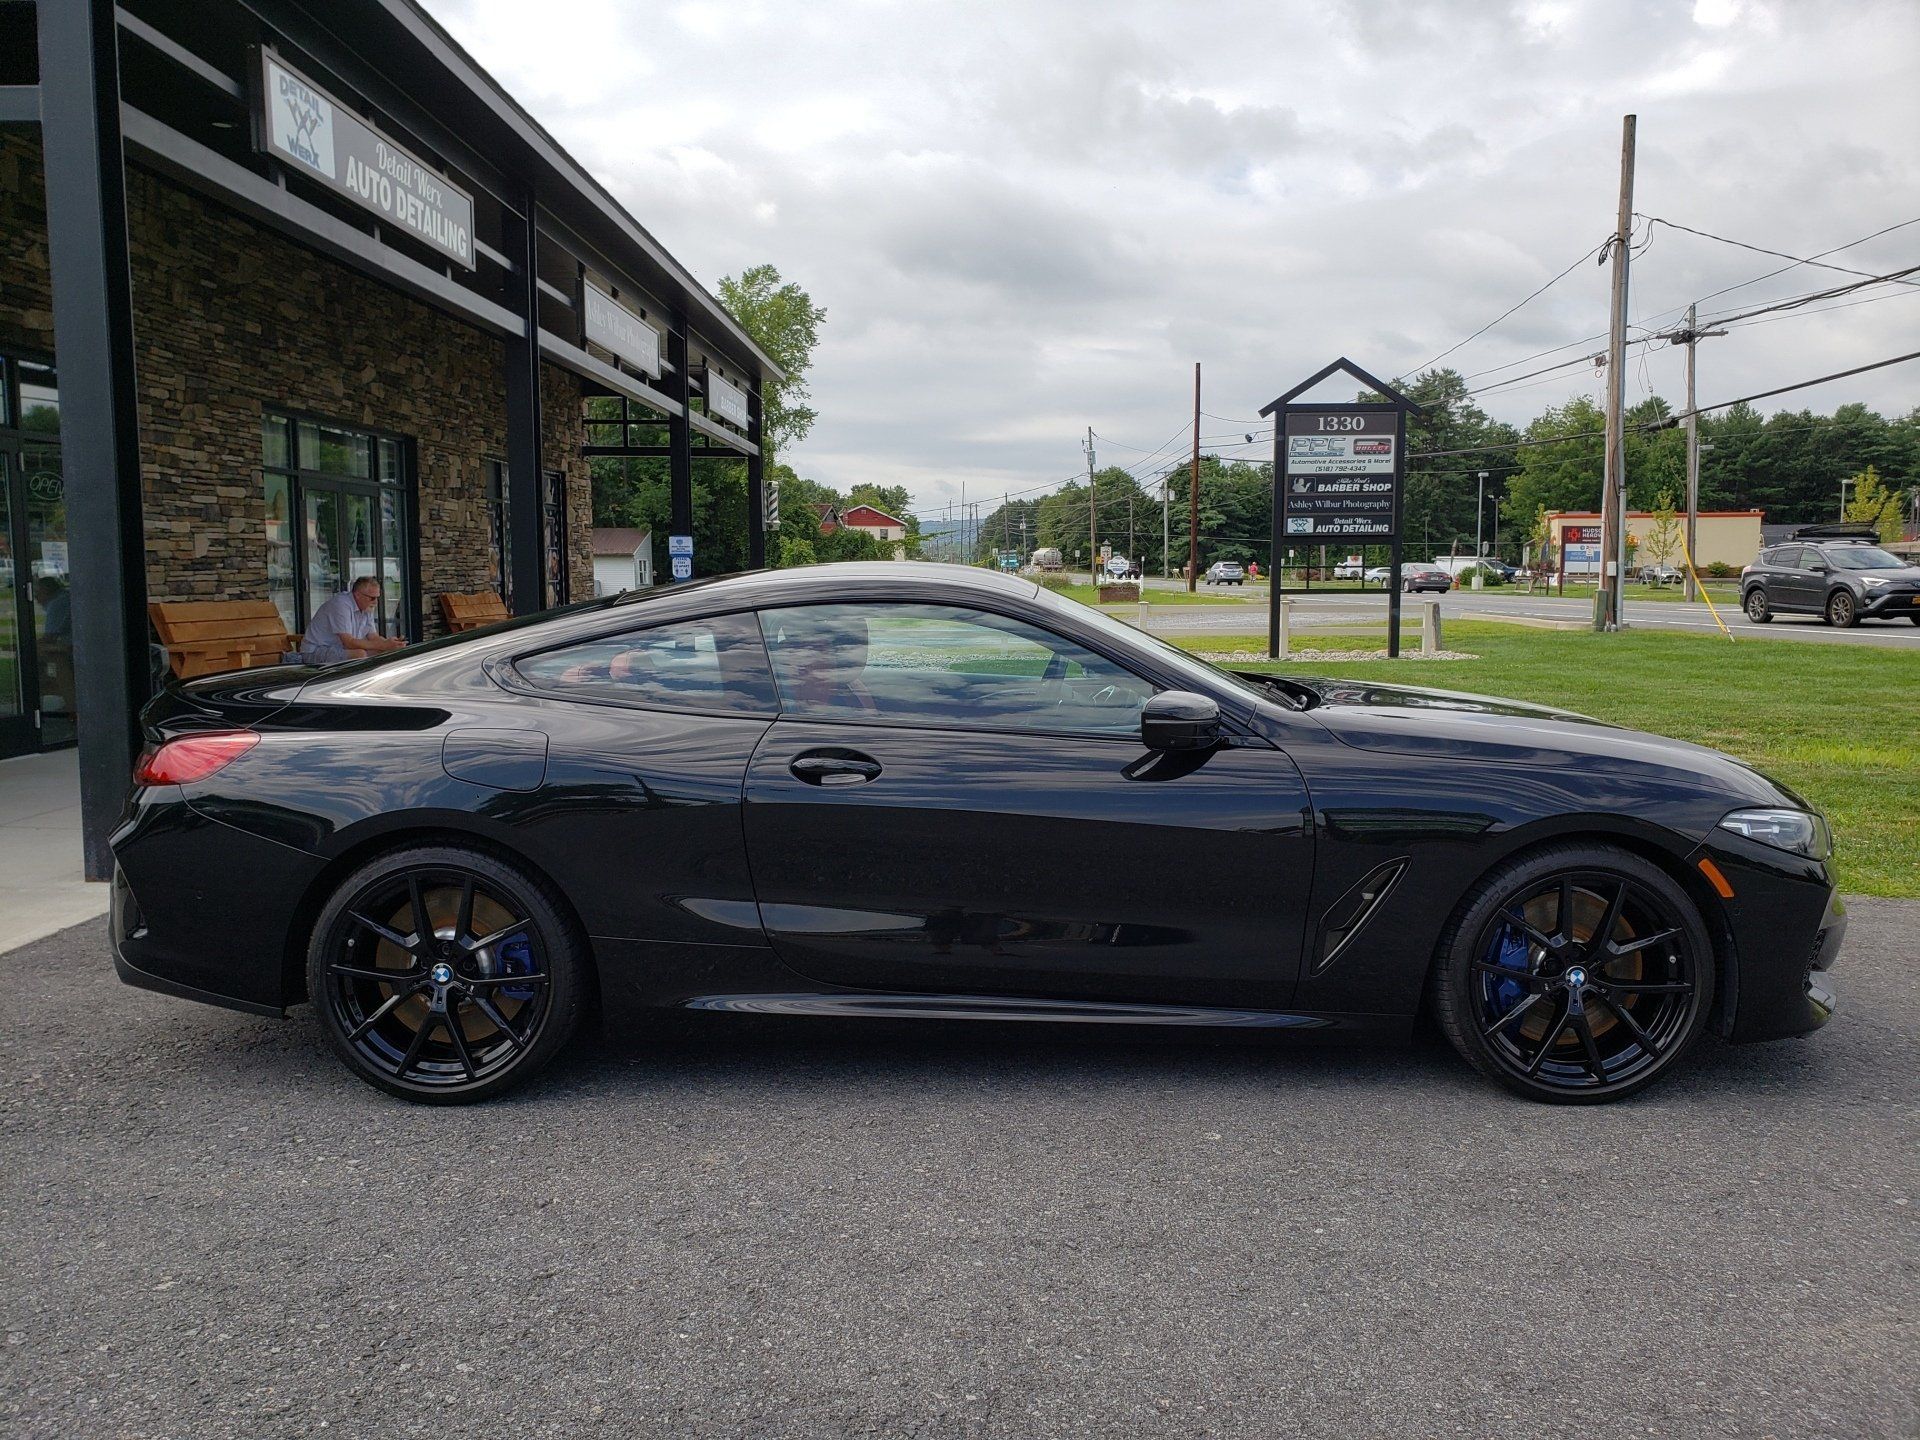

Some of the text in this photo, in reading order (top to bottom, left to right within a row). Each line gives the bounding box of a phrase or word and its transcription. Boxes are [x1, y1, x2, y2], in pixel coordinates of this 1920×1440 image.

[279, 74, 324, 121] DETAIL
[286, 134, 320, 170] WERX
[375, 142, 443, 209] Detail Werx
[346, 155, 467, 258] AUTO DETAILING
[1318, 416, 1365, 431] 1330
[1290, 437, 1346, 451] PPC
[29, 475, 64, 495] OPEN
[1317, 483, 1392, 492] BARBER SHOP
[1288, 500, 1391, 510] Ashley Wilbur Photography
[1315, 525, 1390, 533] AUTO DETAILING
